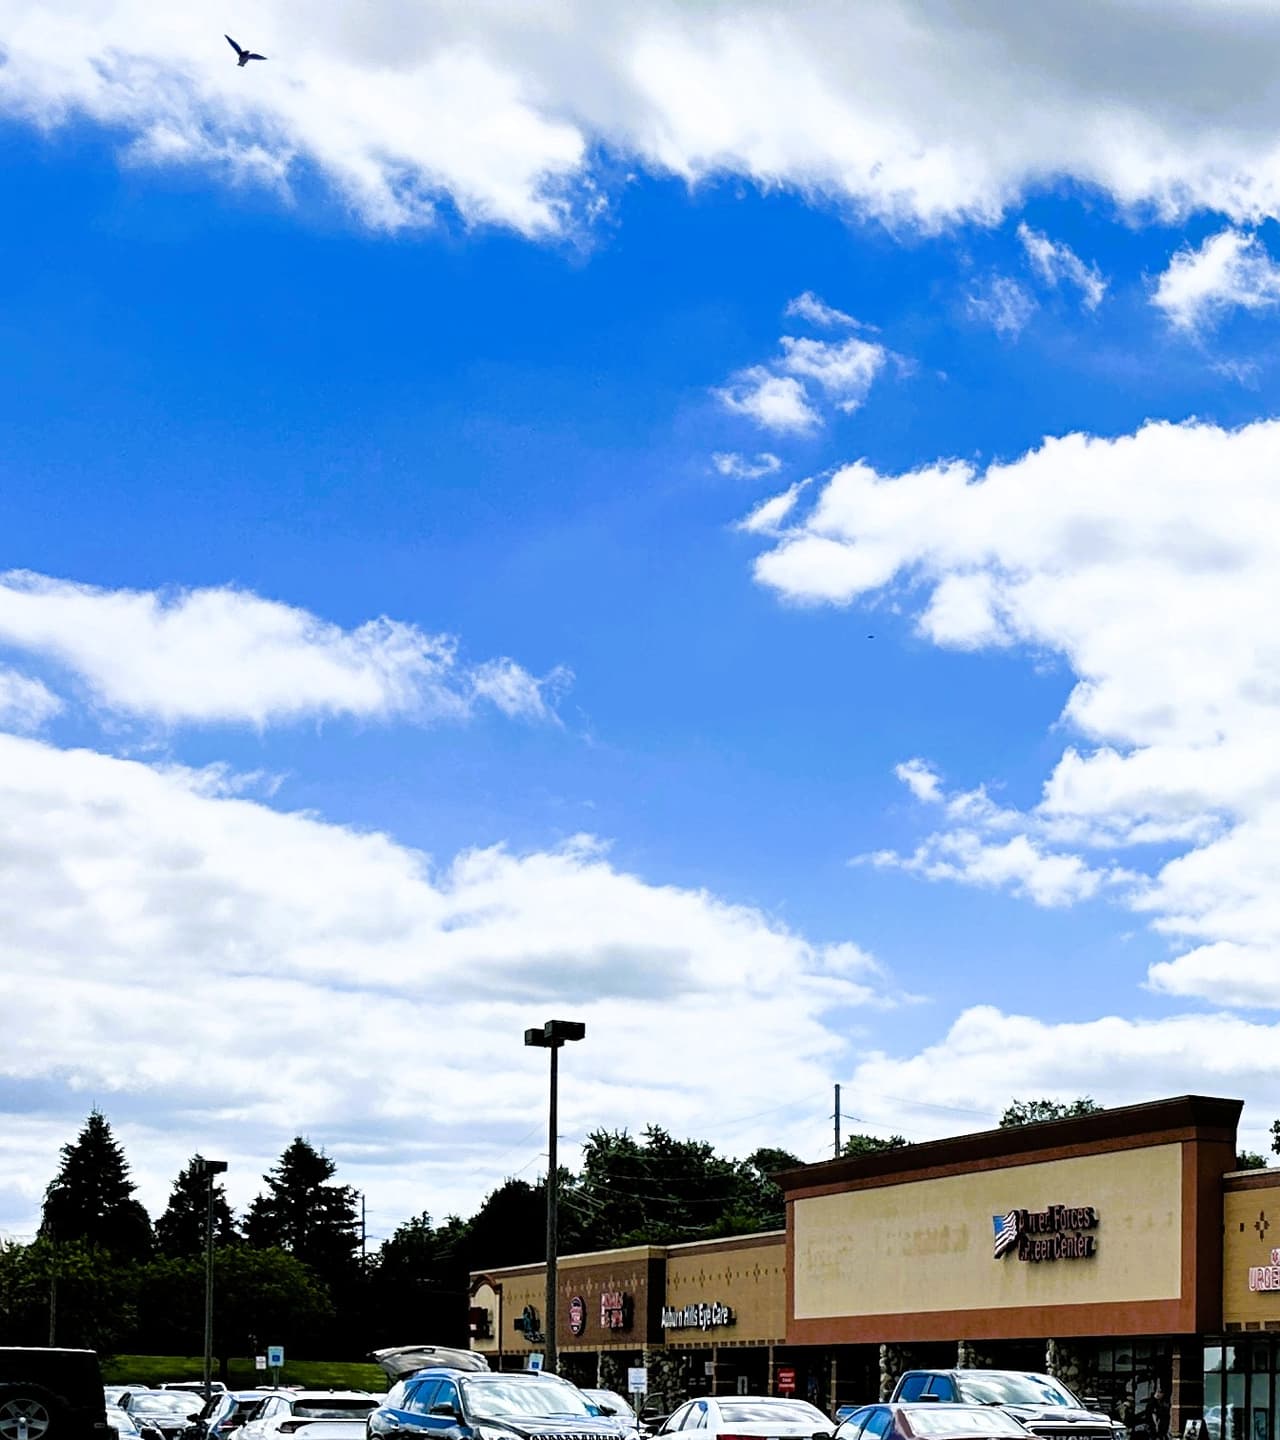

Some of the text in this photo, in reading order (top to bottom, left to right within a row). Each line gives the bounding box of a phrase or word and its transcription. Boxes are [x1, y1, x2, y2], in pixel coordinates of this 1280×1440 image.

[1054, 1205, 1091, 1231] Forces
[1053, 1232, 1089, 1259] Center
[699, 1303, 711, 1331] Eye
[712, 1301, 729, 1325] Care
